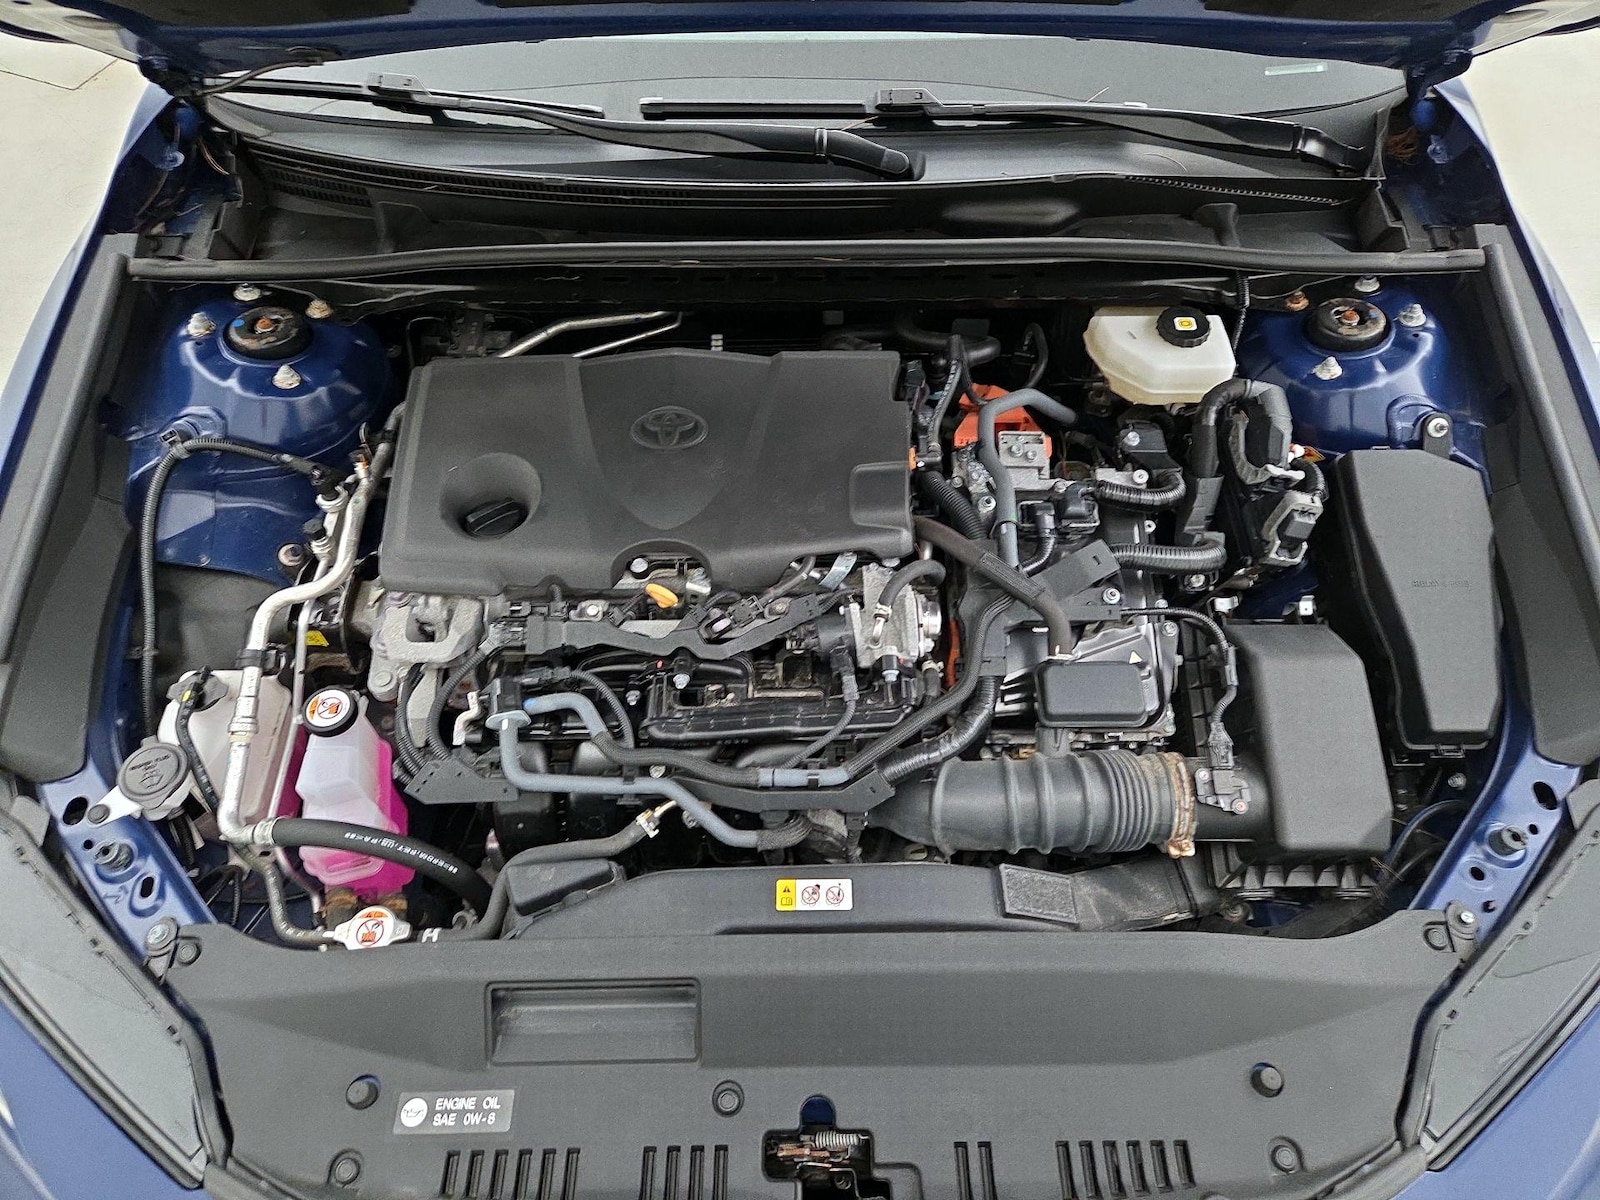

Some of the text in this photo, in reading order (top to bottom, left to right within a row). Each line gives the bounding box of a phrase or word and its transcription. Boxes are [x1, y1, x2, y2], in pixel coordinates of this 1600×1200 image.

[435, 1096, 501, 1111] ENGINE OIL
[432, 1112, 496, 1126] SAE 0W-8
